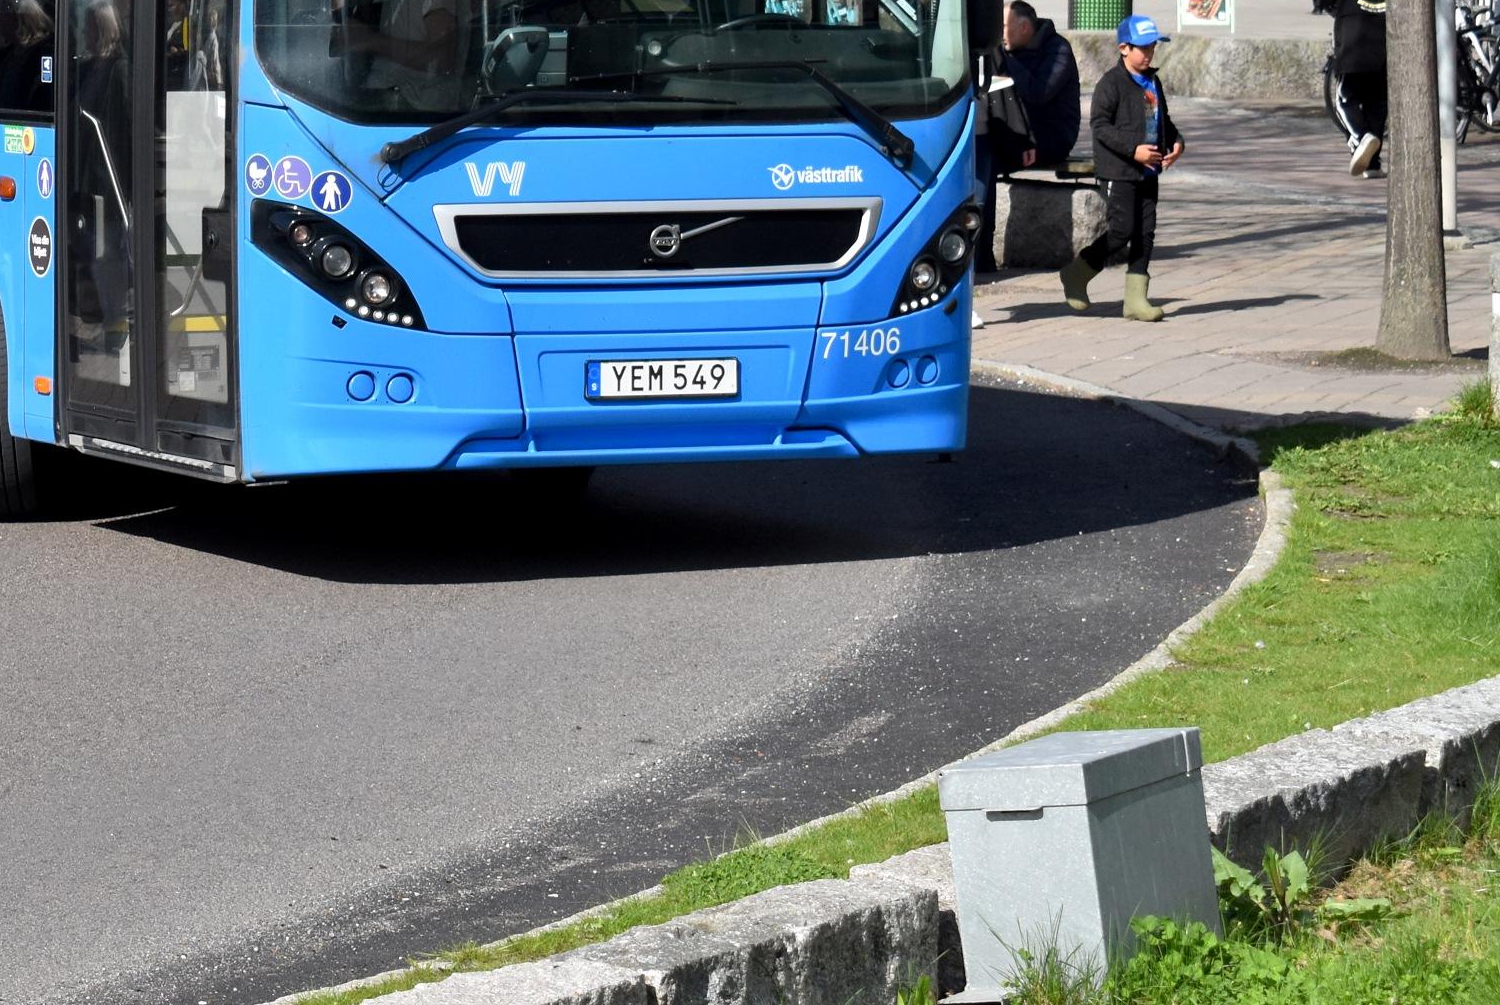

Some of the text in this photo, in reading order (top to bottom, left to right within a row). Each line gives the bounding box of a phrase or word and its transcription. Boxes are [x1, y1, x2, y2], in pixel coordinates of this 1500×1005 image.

[797, 165, 864, 184] västtrafik
[821, 327, 901, 359] 71406
[612, 363, 726, 392] YEM 549
